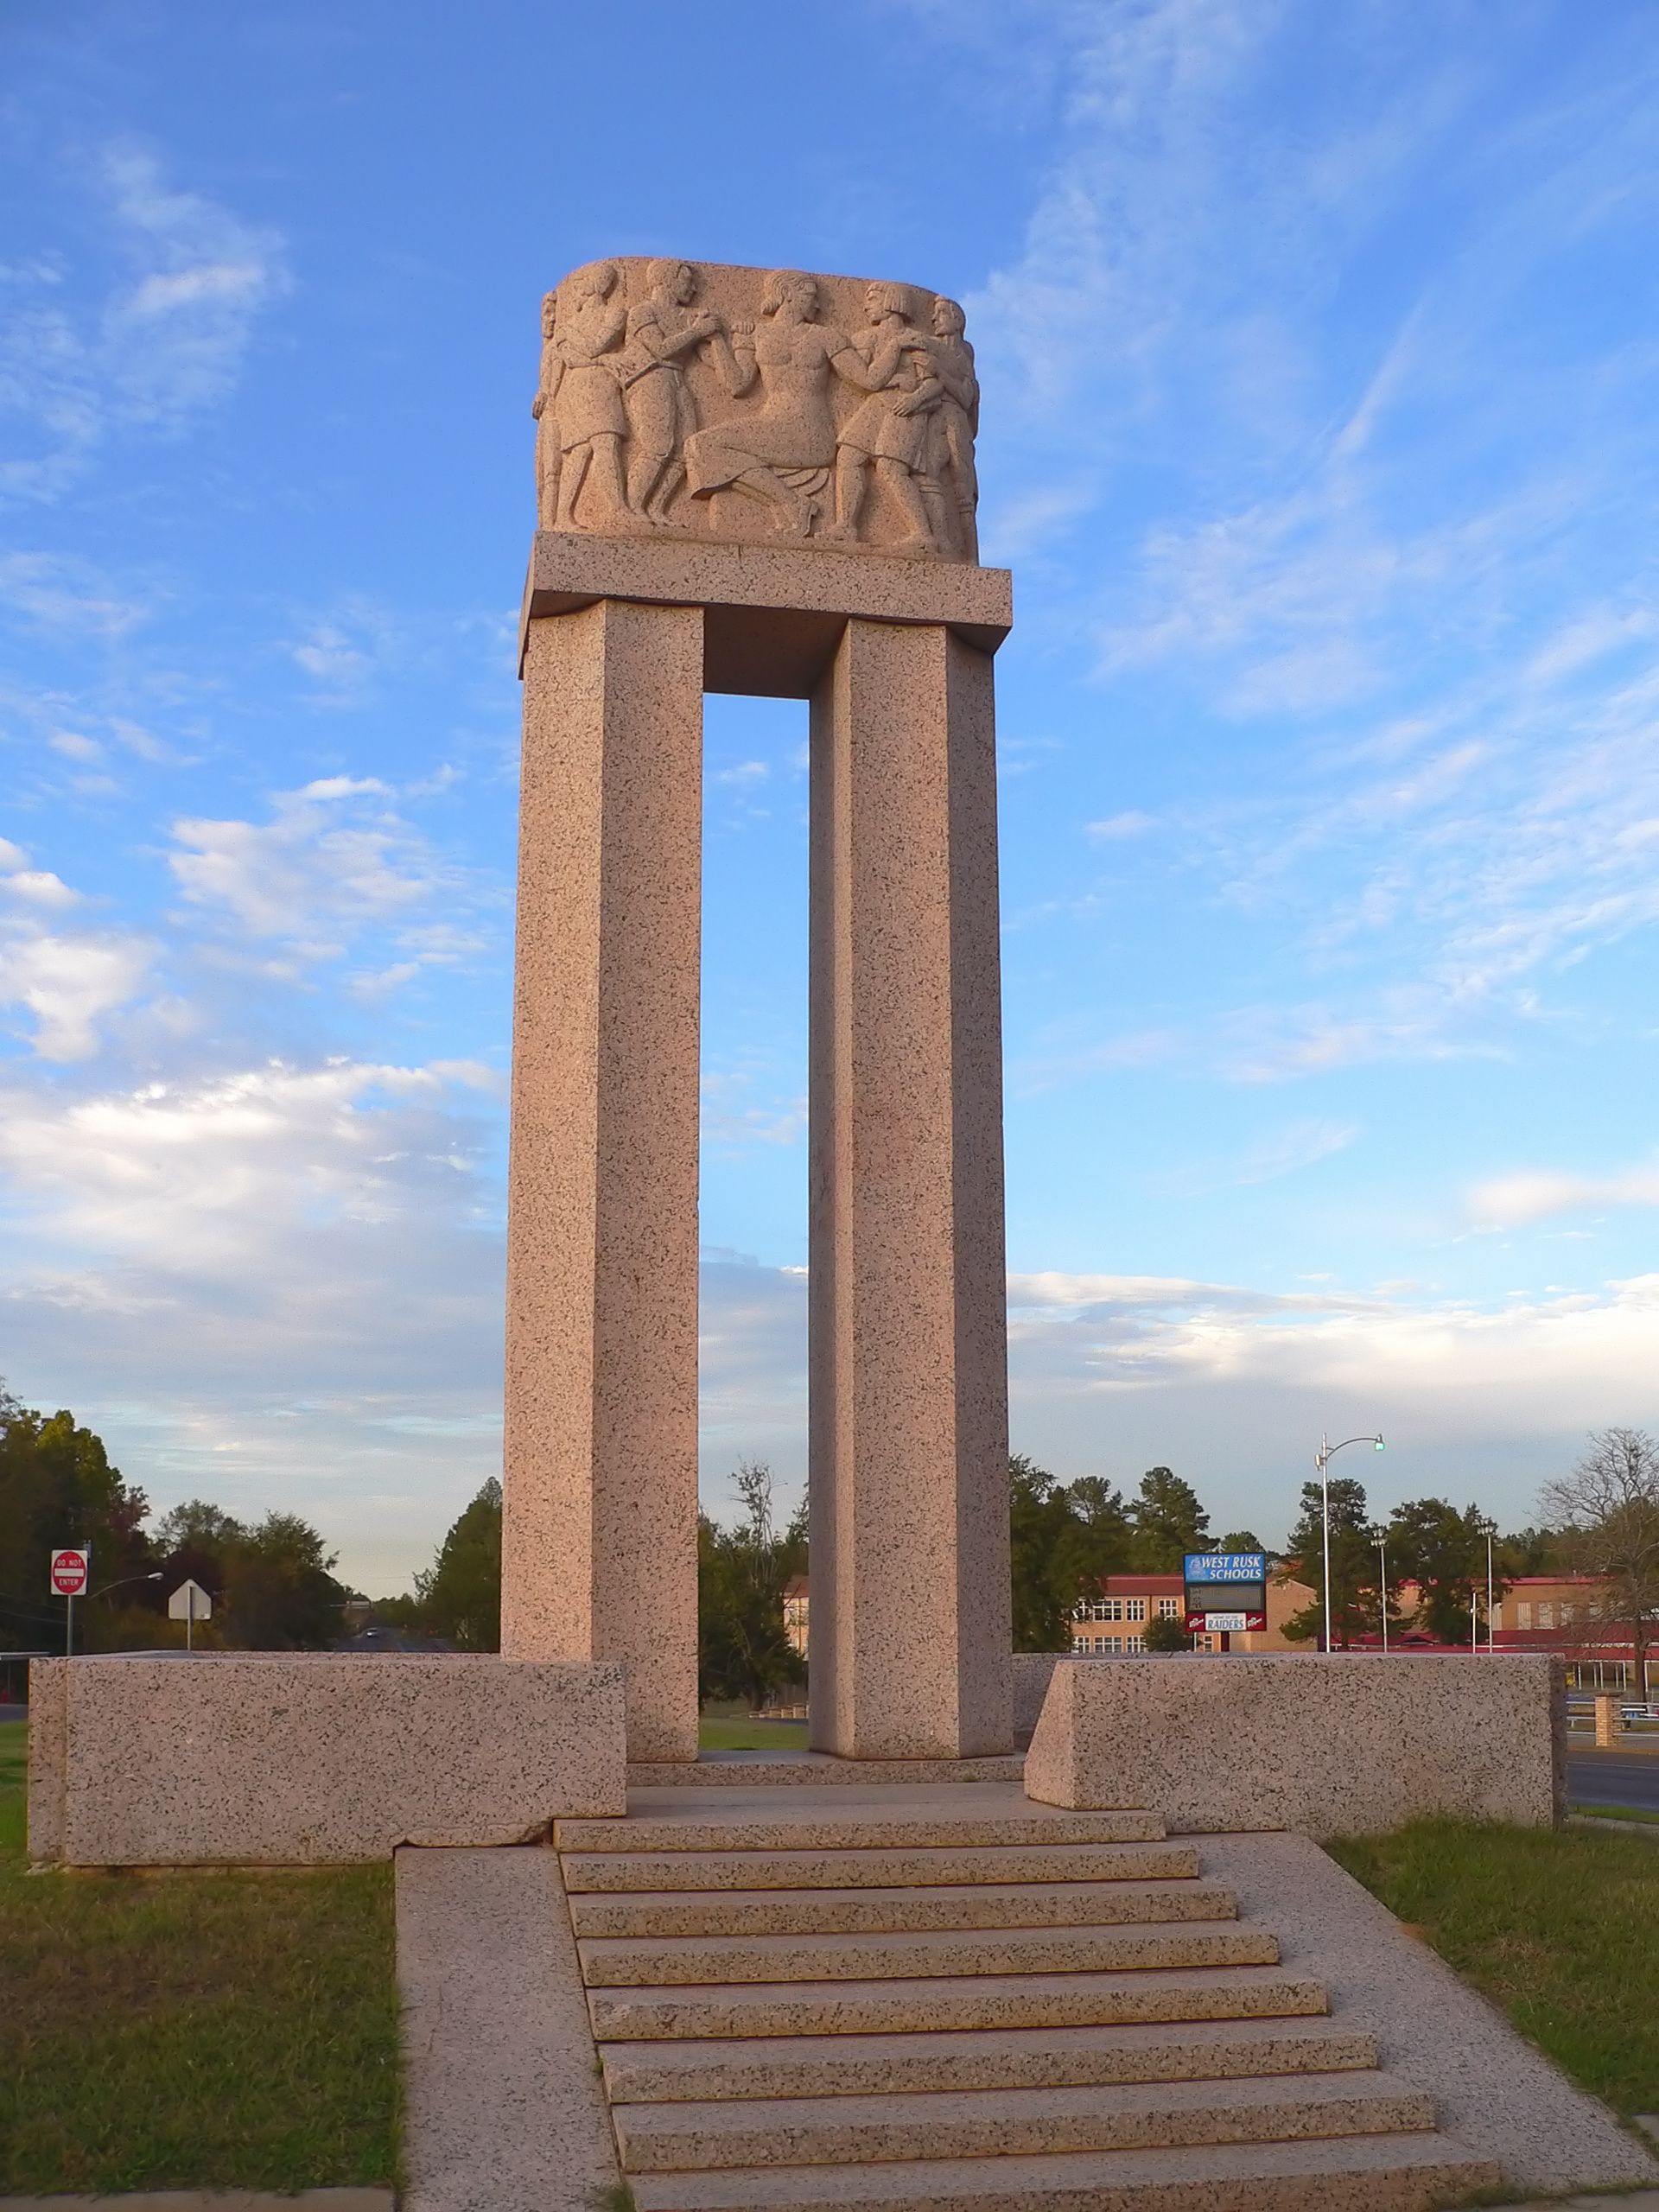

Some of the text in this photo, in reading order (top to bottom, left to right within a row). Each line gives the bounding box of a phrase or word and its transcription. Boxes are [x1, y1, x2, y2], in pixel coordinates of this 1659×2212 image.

[1202, 1556, 1261, 1568] WEST RUSK
[1210, 1568, 1262, 1580] SCHOOLS
[1208, 1619, 1243, 1630] RAIDERS
